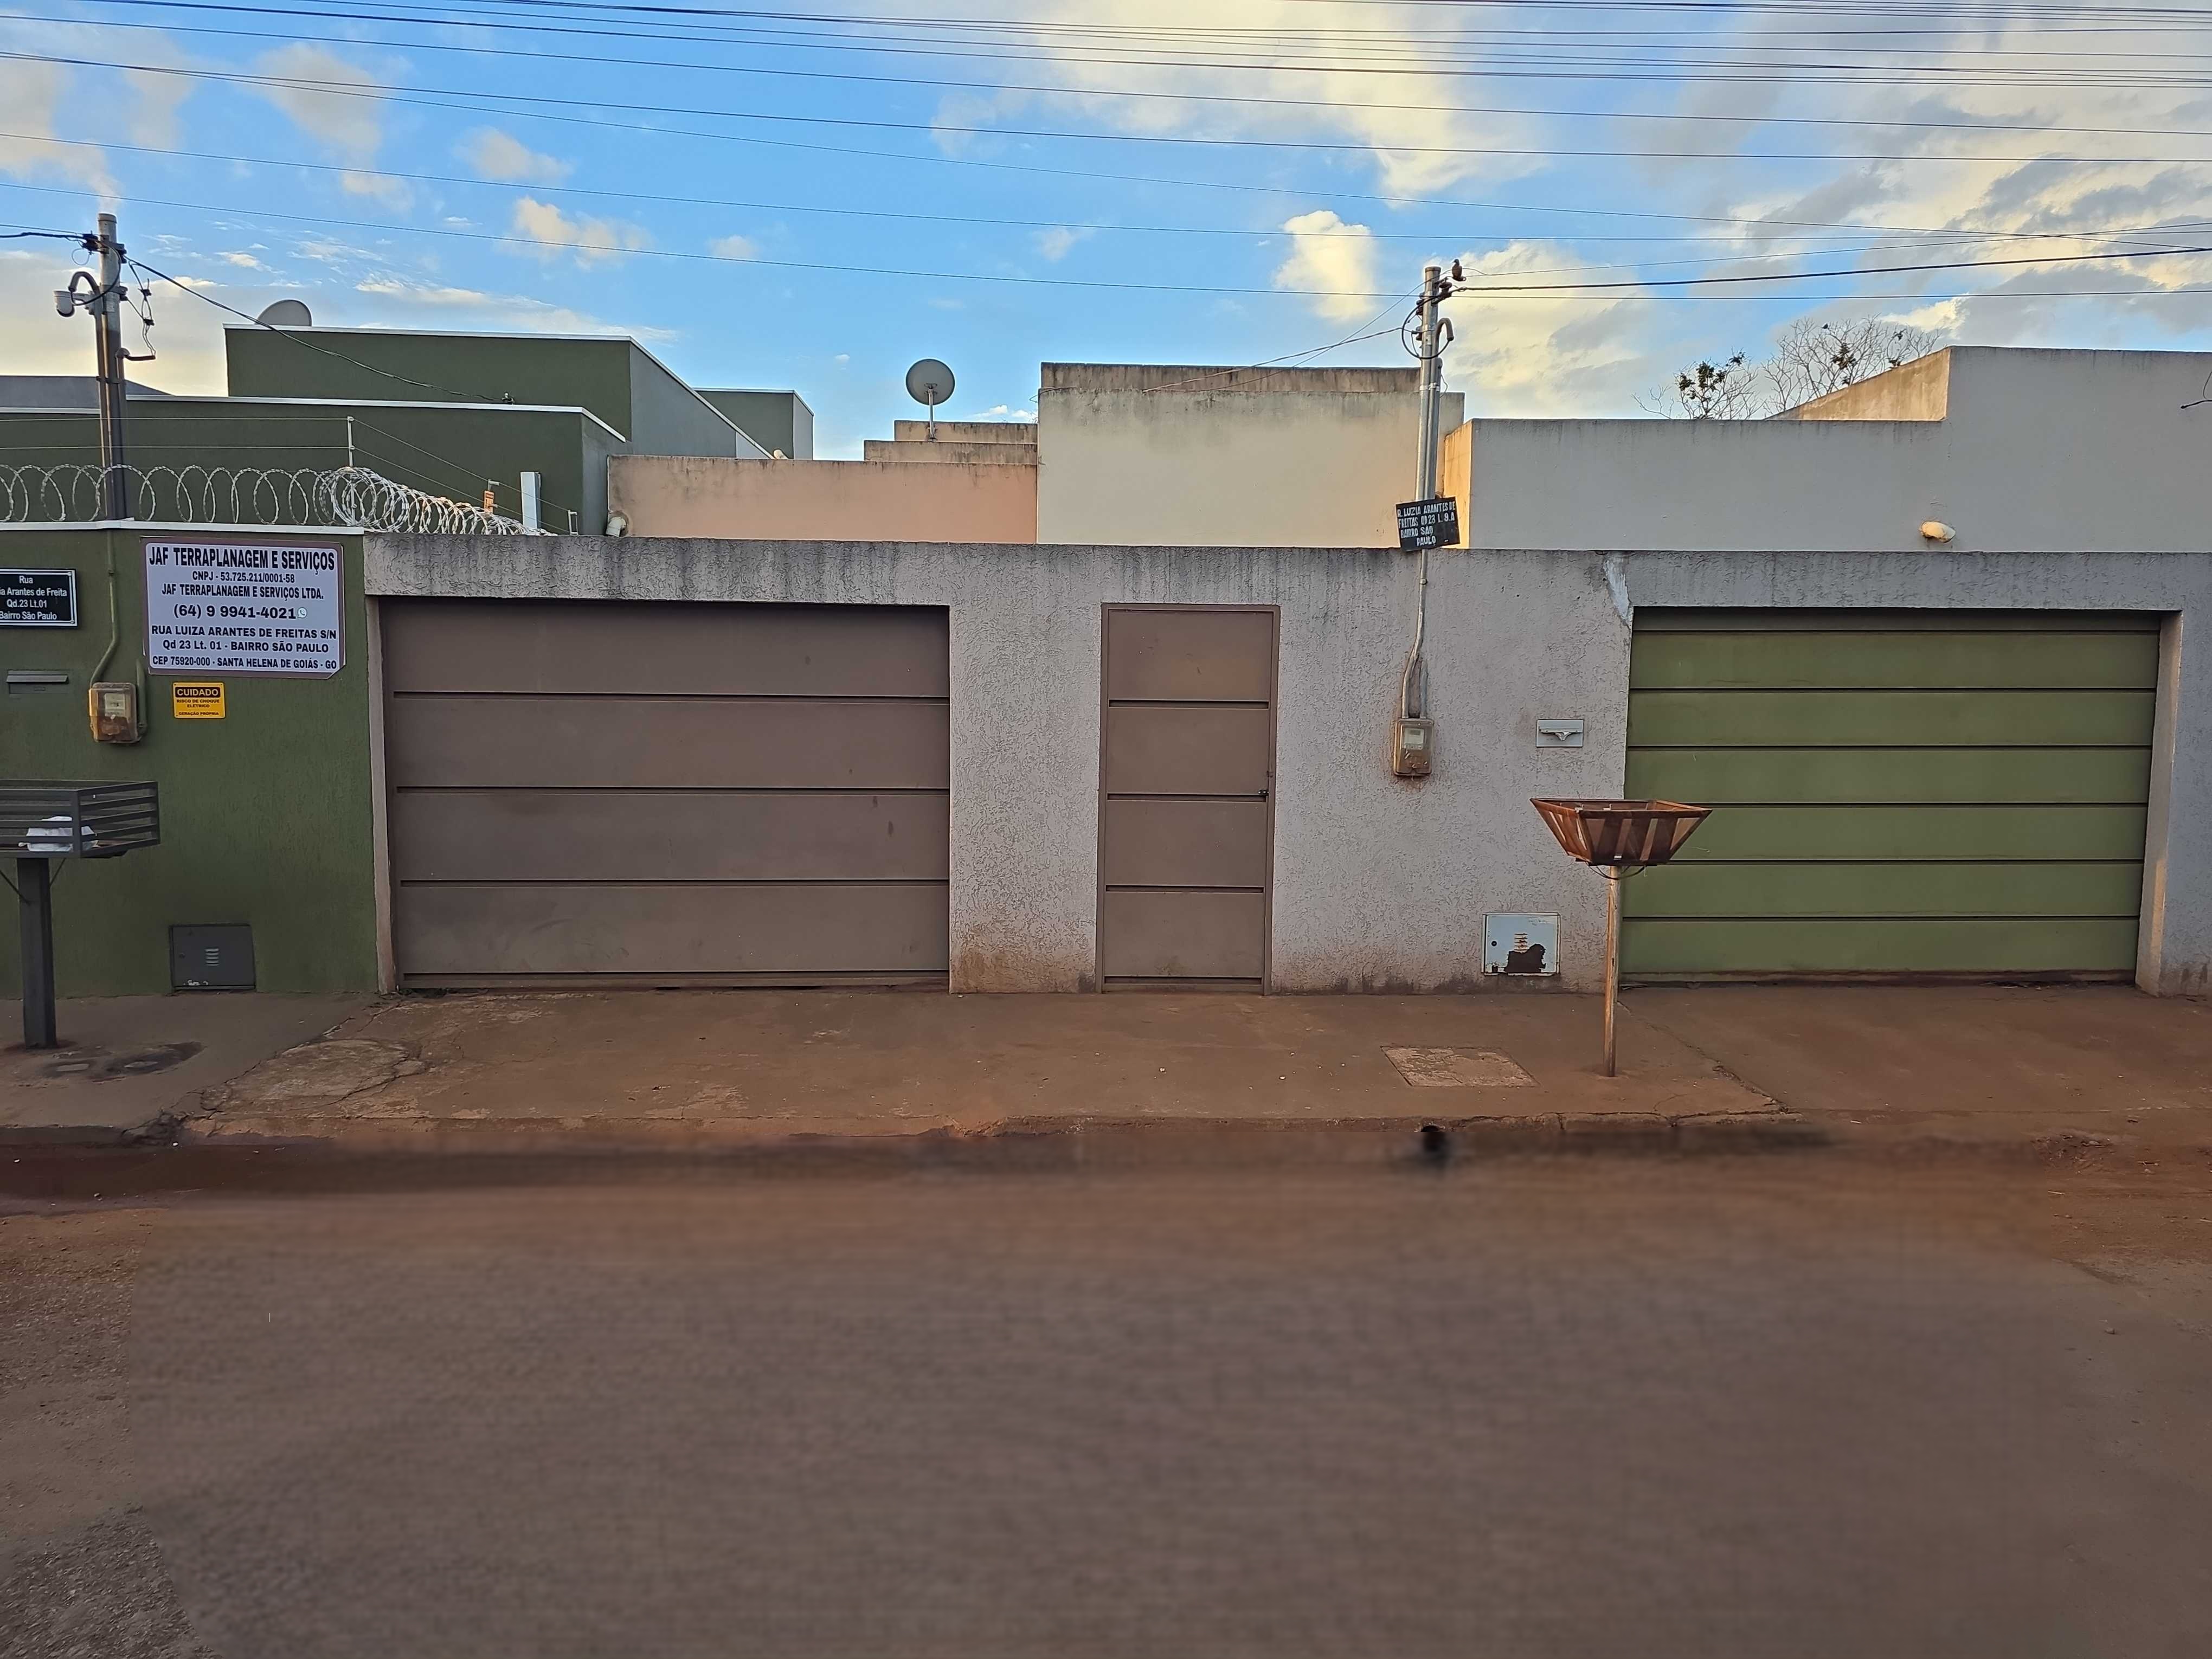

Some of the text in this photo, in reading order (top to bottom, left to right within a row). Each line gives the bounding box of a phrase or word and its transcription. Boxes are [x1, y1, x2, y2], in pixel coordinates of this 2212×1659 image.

[1404, 506, 1421, 517] LUZIA
[1423, 502, 1448, 514] ARANTES
[1449, 501, 1456, 511] DE
[1398, 517, 1419, 529] FREITAS
[1428, 514, 1436, 524] 23
[1400, 528, 1419, 538] BAIRRO
[1416, 535, 1436, 546] PAULO
[149, 546, 335, 575] JAF TERRAPLANAGEM E SERVIÇOS
[19, 575, 34, 584] Rua
[192, 571, 214, 581] CNPJ
[220, 571, 295, 583] 53.725.211/0001-58
[7, 587, 35, 596] Arantes
[35, 587, 46, 596] de
[162, 583, 324, 601] JAF TERRAPLANAGEM E SERVIÇOS LTDA.
[7, 599, 28, 608] Qd.23
[22, 610, 36, 620] São
[37, 611, 57, 620] Paulo
[173, 603, 296, 619] (64) 9 9941-4021
[151, 625, 336, 639] RUA LUIZA ARANTES DE FREITAS S/N
[163, 640, 176, 650] Qd
[179, 640, 191, 649] 23
[194, 641, 207, 650] Lt.
[210, 641, 222, 650] 01
[230, 641, 269, 651] BAIRRO
[272, 640, 293, 652] SÃO
[296, 643, 329, 653] PAULO
[152, 655, 168, 665] CEP
[170, 656, 210, 666] 75920-000
[217, 658, 244, 667] SANTA
[246, 658, 278, 668] HELENA
[280, 659, 291, 668] DE
[293, 658, 318, 669] GOIÁS
[325, 660, 337, 669] GO
